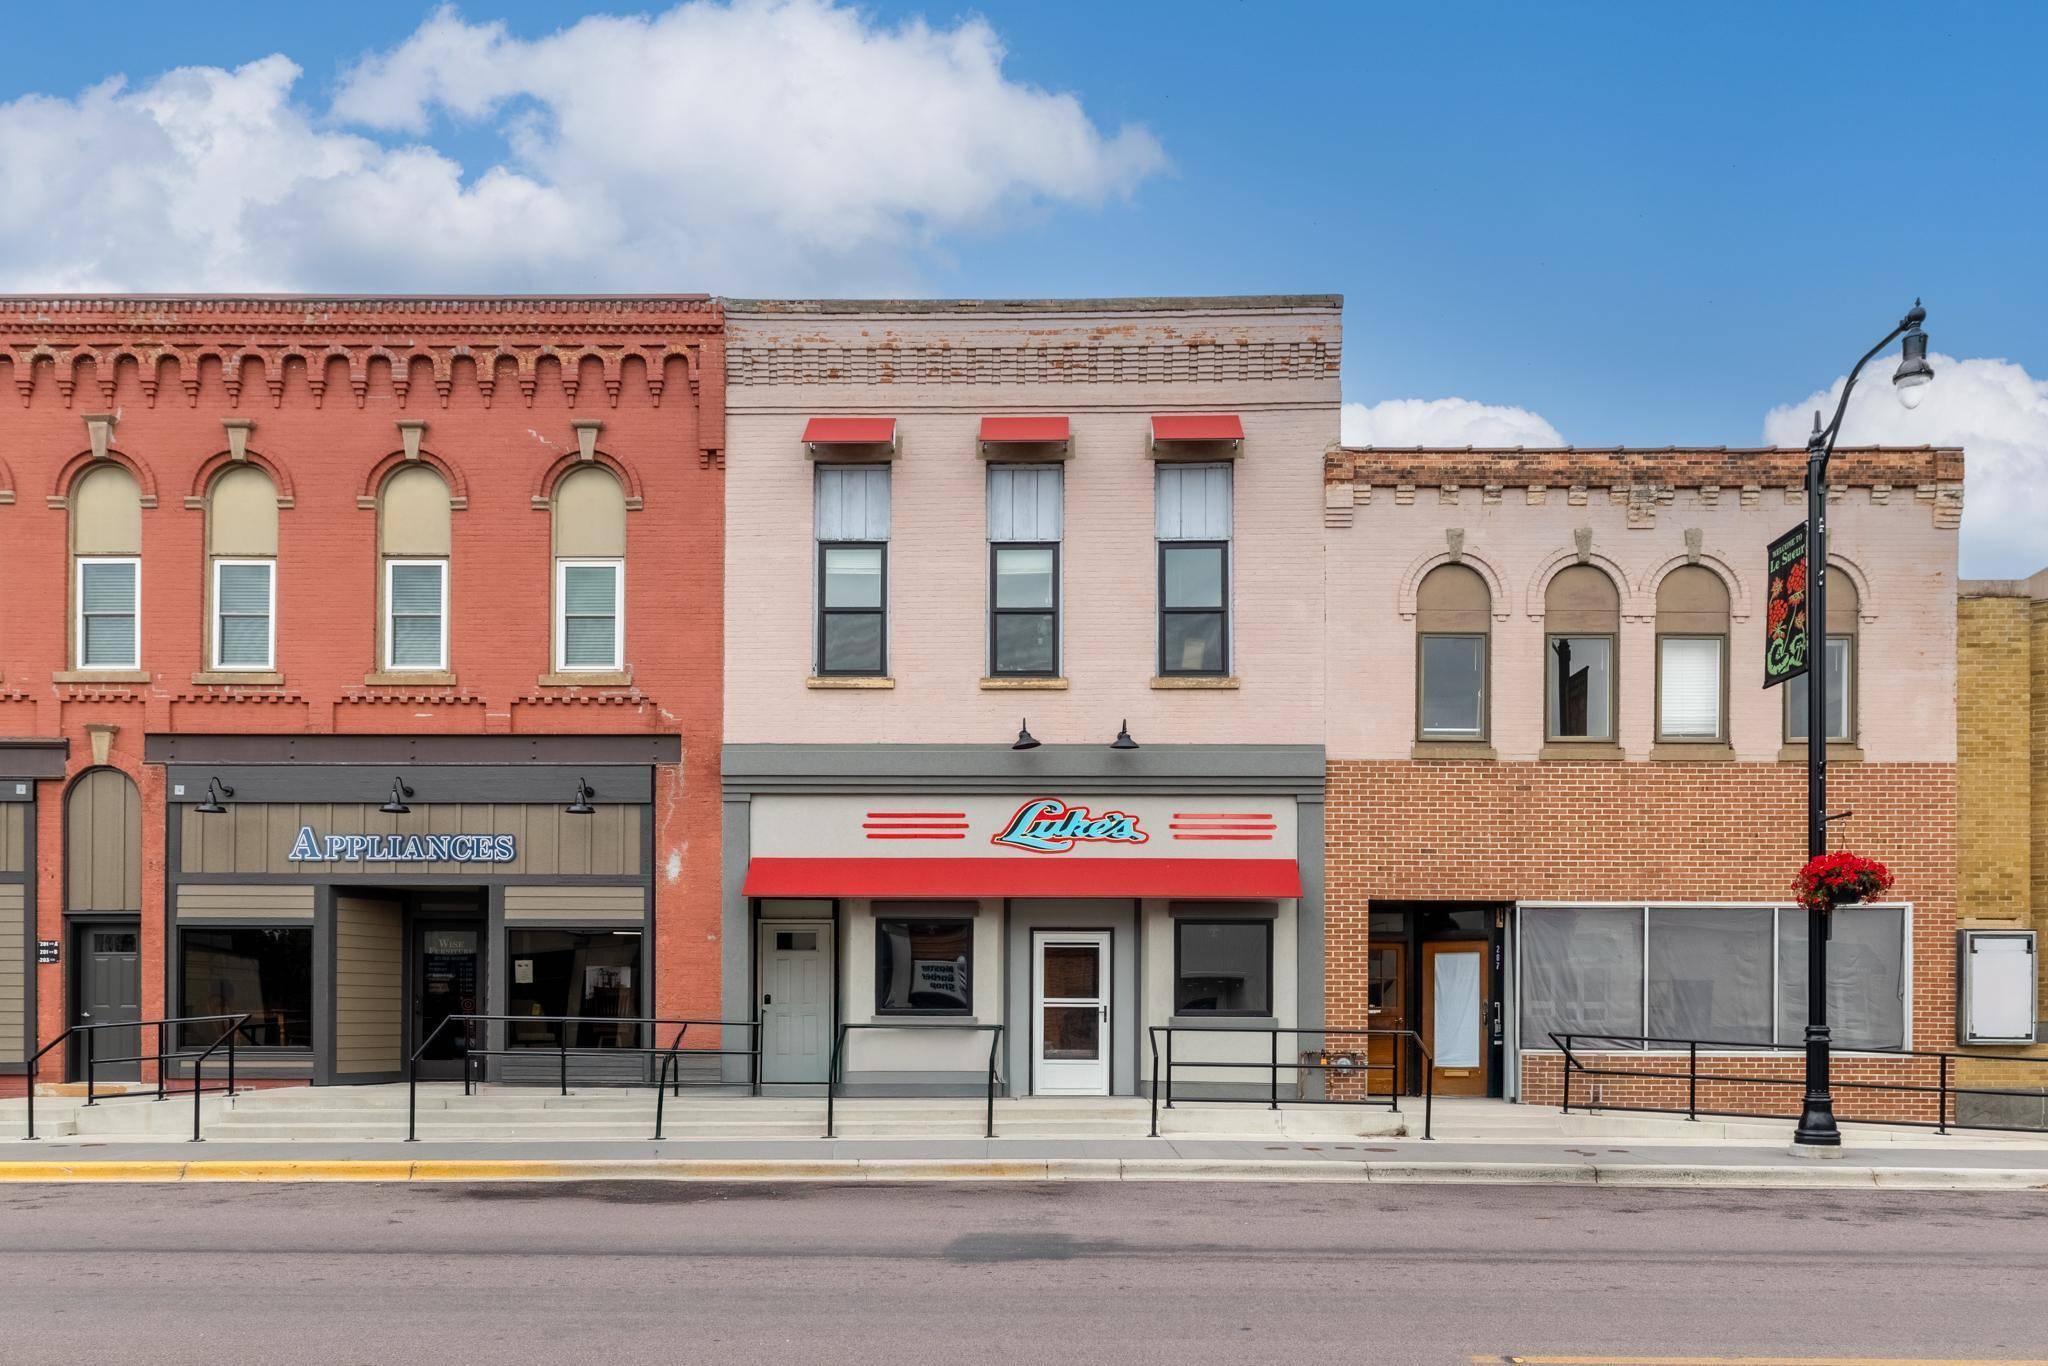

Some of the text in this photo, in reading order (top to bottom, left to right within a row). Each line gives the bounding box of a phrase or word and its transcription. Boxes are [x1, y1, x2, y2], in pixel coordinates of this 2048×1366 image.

[1769, 543, 1806, 574] Le Sueur
[1772, 533, 1803, 559] WELCOME TO
[992, 799, 1148, 853] Luke's
[288, 825, 515, 863] APPLIANCES
